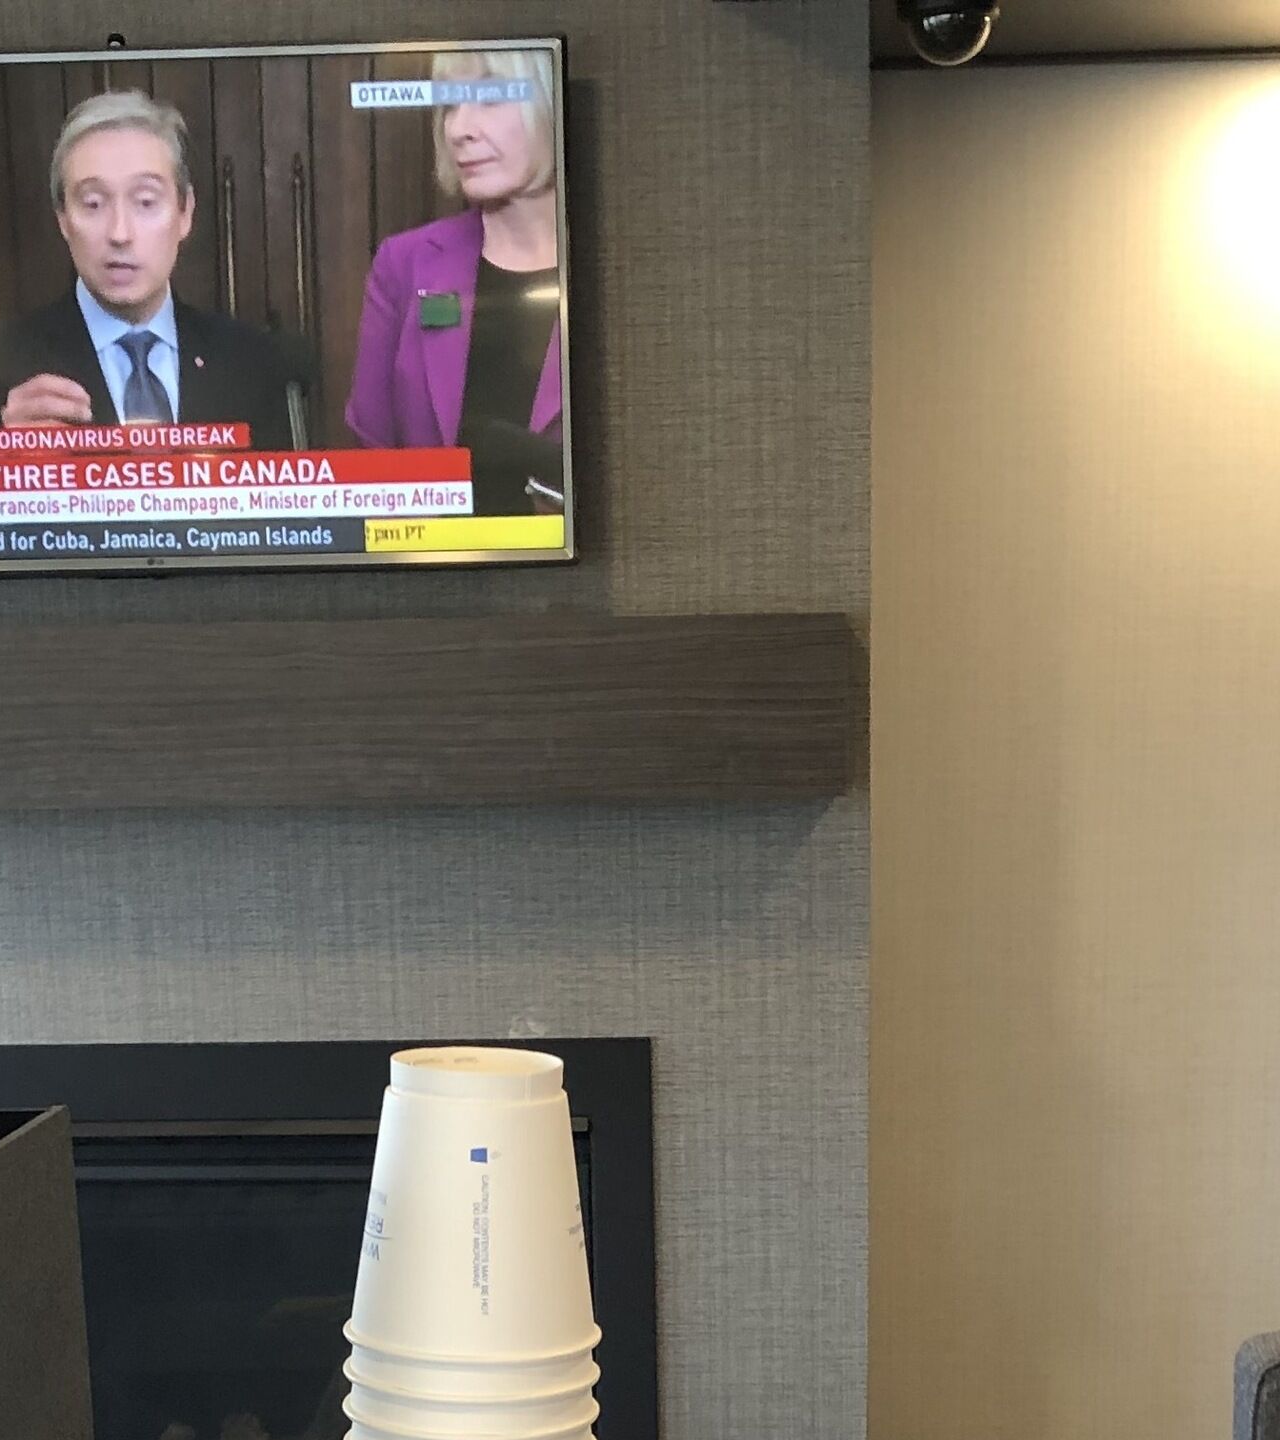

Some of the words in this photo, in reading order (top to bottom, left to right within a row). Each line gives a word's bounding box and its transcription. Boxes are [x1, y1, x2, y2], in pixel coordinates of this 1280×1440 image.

[358, 86, 425, 103] OTTAWA
[129, 426, 236, 447] OUTBREAK
[85, 461, 175, 488] CASES
[183, 460, 211, 486] IN
[220, 457, 336, 485] CANADA
[140, 493, 245, 516] Champagne,
[249, 491, 317, 511] Minister
[322, 489, 337, 508] of
[343, 487, 407, 512] Foreign
[412, 486, 468, 507] Affairs
[10, 530, 37, 550] for
[42, 529, 95, 552] Cuba,
[99, 528, 182, 550] Jamaica,
[186, 526, 261, 552] Cayman
[265, 525, 333, 547] Islands
